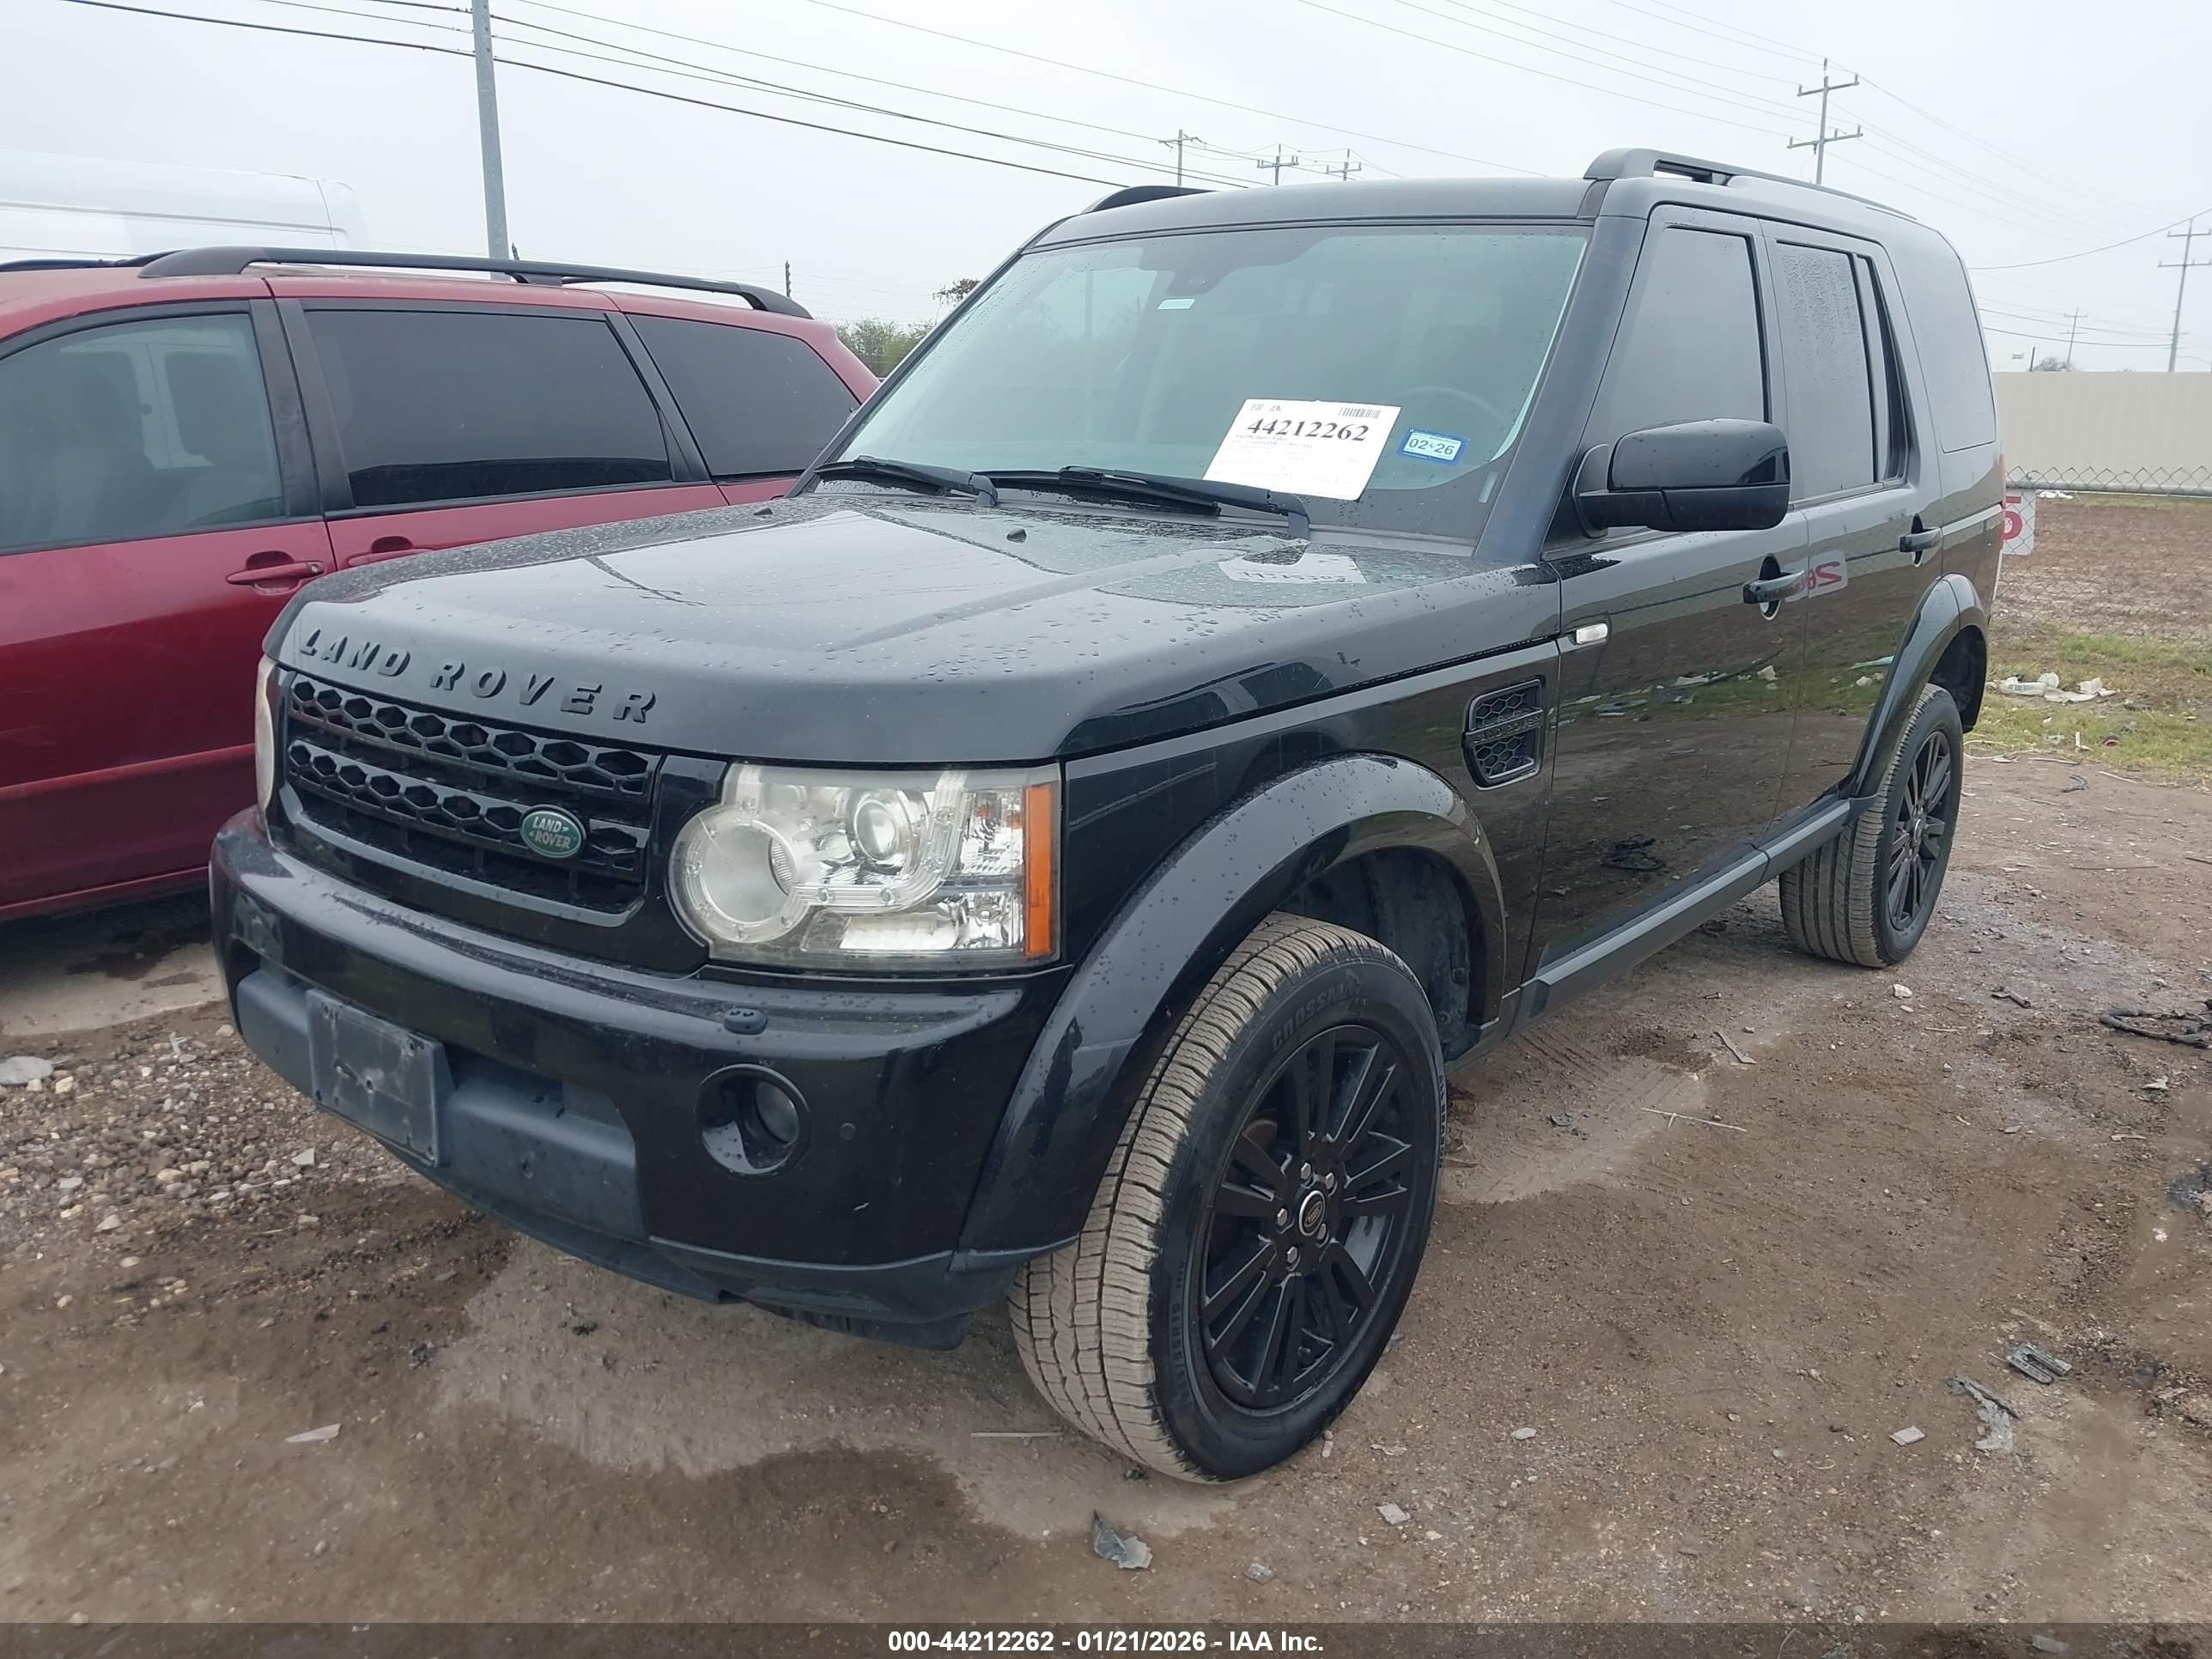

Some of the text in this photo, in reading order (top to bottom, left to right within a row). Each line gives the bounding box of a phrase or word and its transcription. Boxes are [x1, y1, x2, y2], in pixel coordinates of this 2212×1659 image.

[1248, 418, 1369, 441] 44212262
[301, 629, 657, 723] LAND ROVER
[532, 816, 562, 833] LAND
[535, 830, 571, 849] ROVER
